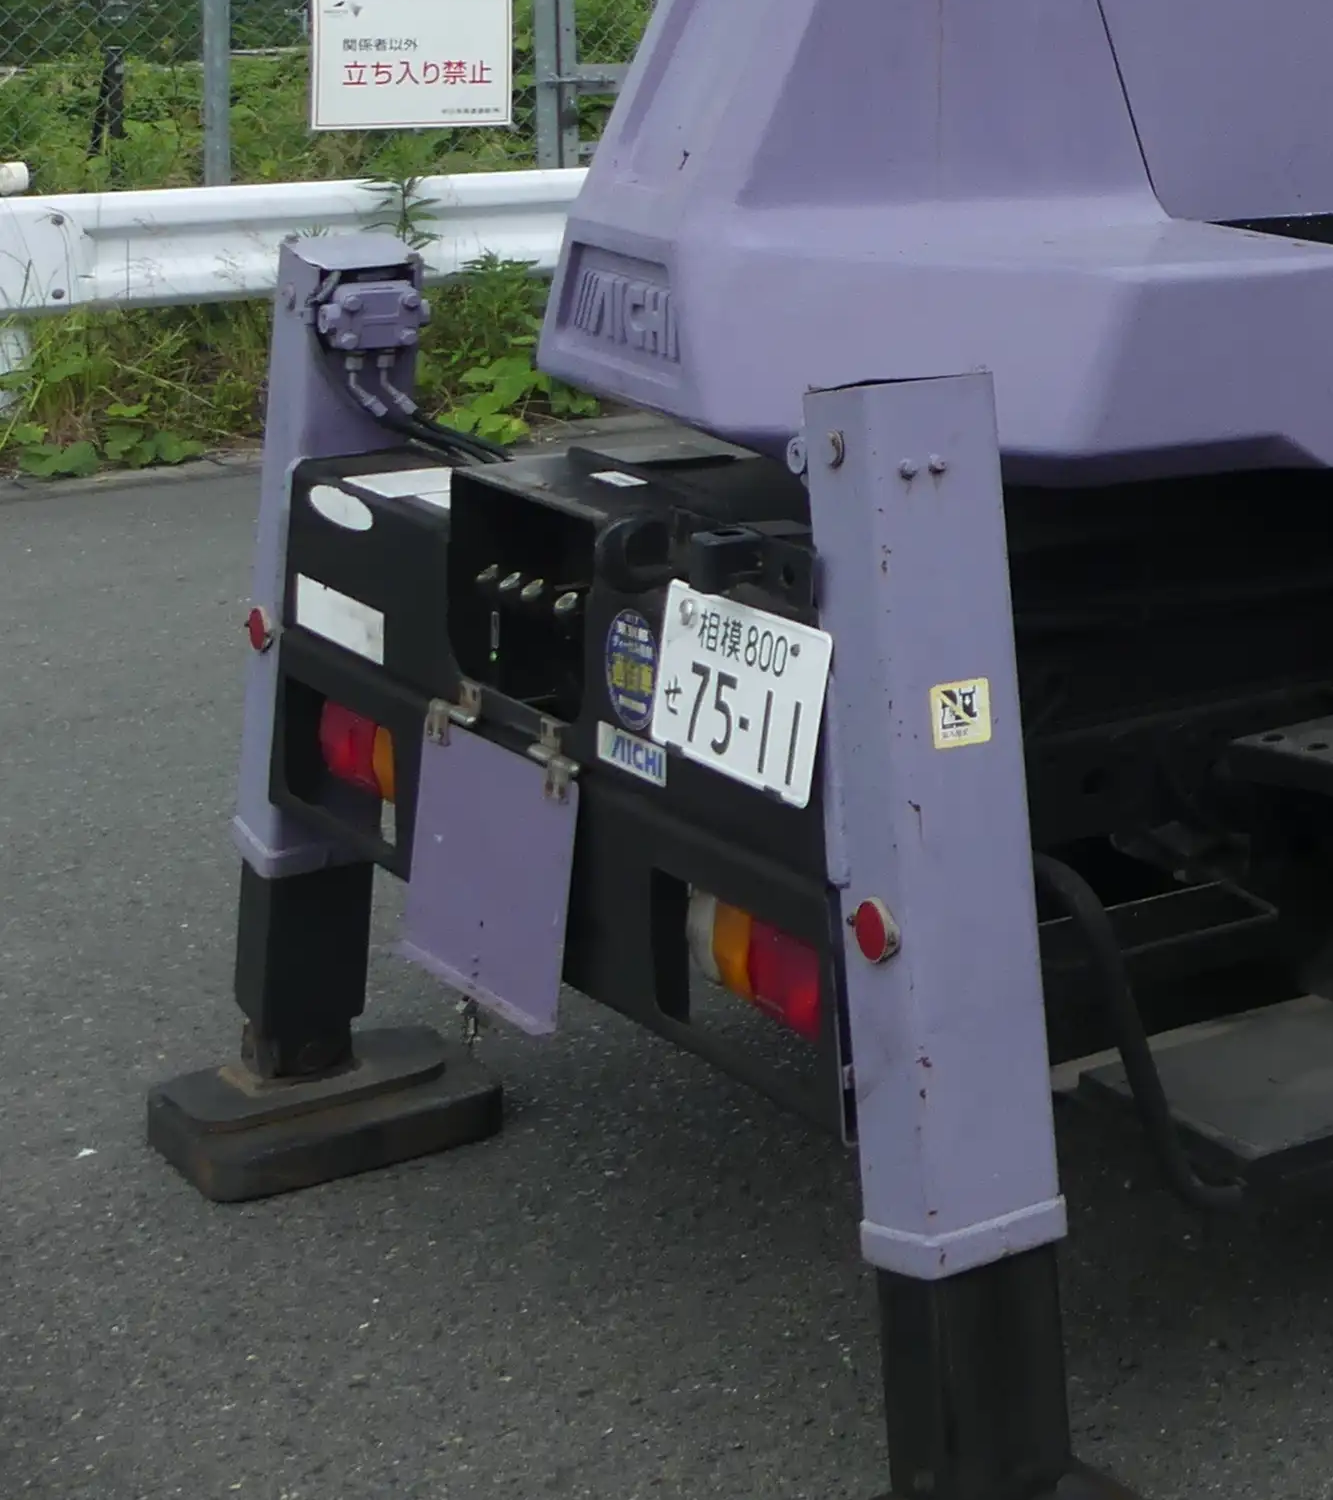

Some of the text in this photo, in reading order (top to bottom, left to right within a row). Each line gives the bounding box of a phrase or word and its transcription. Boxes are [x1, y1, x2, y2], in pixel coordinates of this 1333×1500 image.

[343, 38, 418, 52] 関係者以外
[343, 60, 492, 86] 立ち入り禁止
[576, 270, 680, 364] AICHI
[610, 734, 663, 781] AICHI
